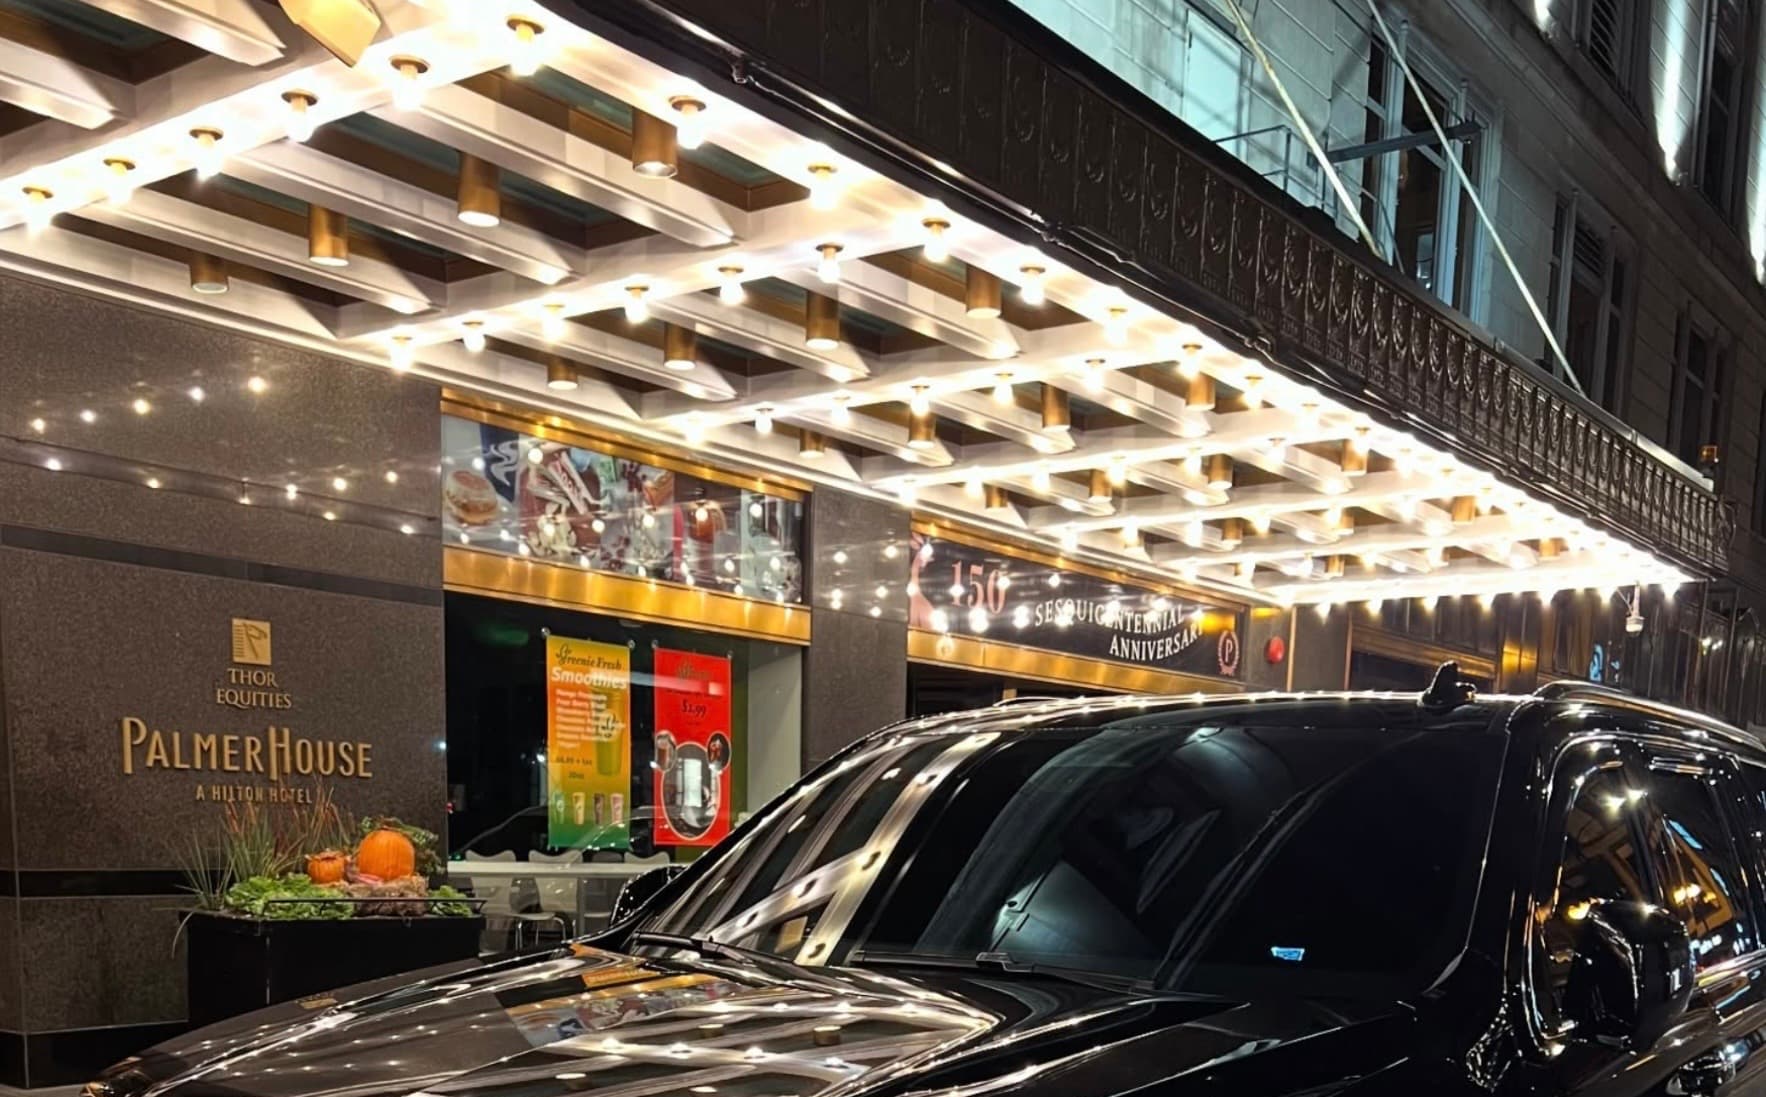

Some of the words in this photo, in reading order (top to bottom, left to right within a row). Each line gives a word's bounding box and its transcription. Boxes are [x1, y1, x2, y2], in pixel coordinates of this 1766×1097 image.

[951, 560, 1007, 615] 150
[1034, 597, 1185, 635] SESQUICNTENNIAL
[226, 667, 279, 688] THOR
[551, 665, 628, 689] Smoothies
[215, 688, 293, 709] EQUITIES
[195, 787, 206, 802] A
[211, 785, 264, 804] HILTON
[268, 786, 314, 805] HOTEL
